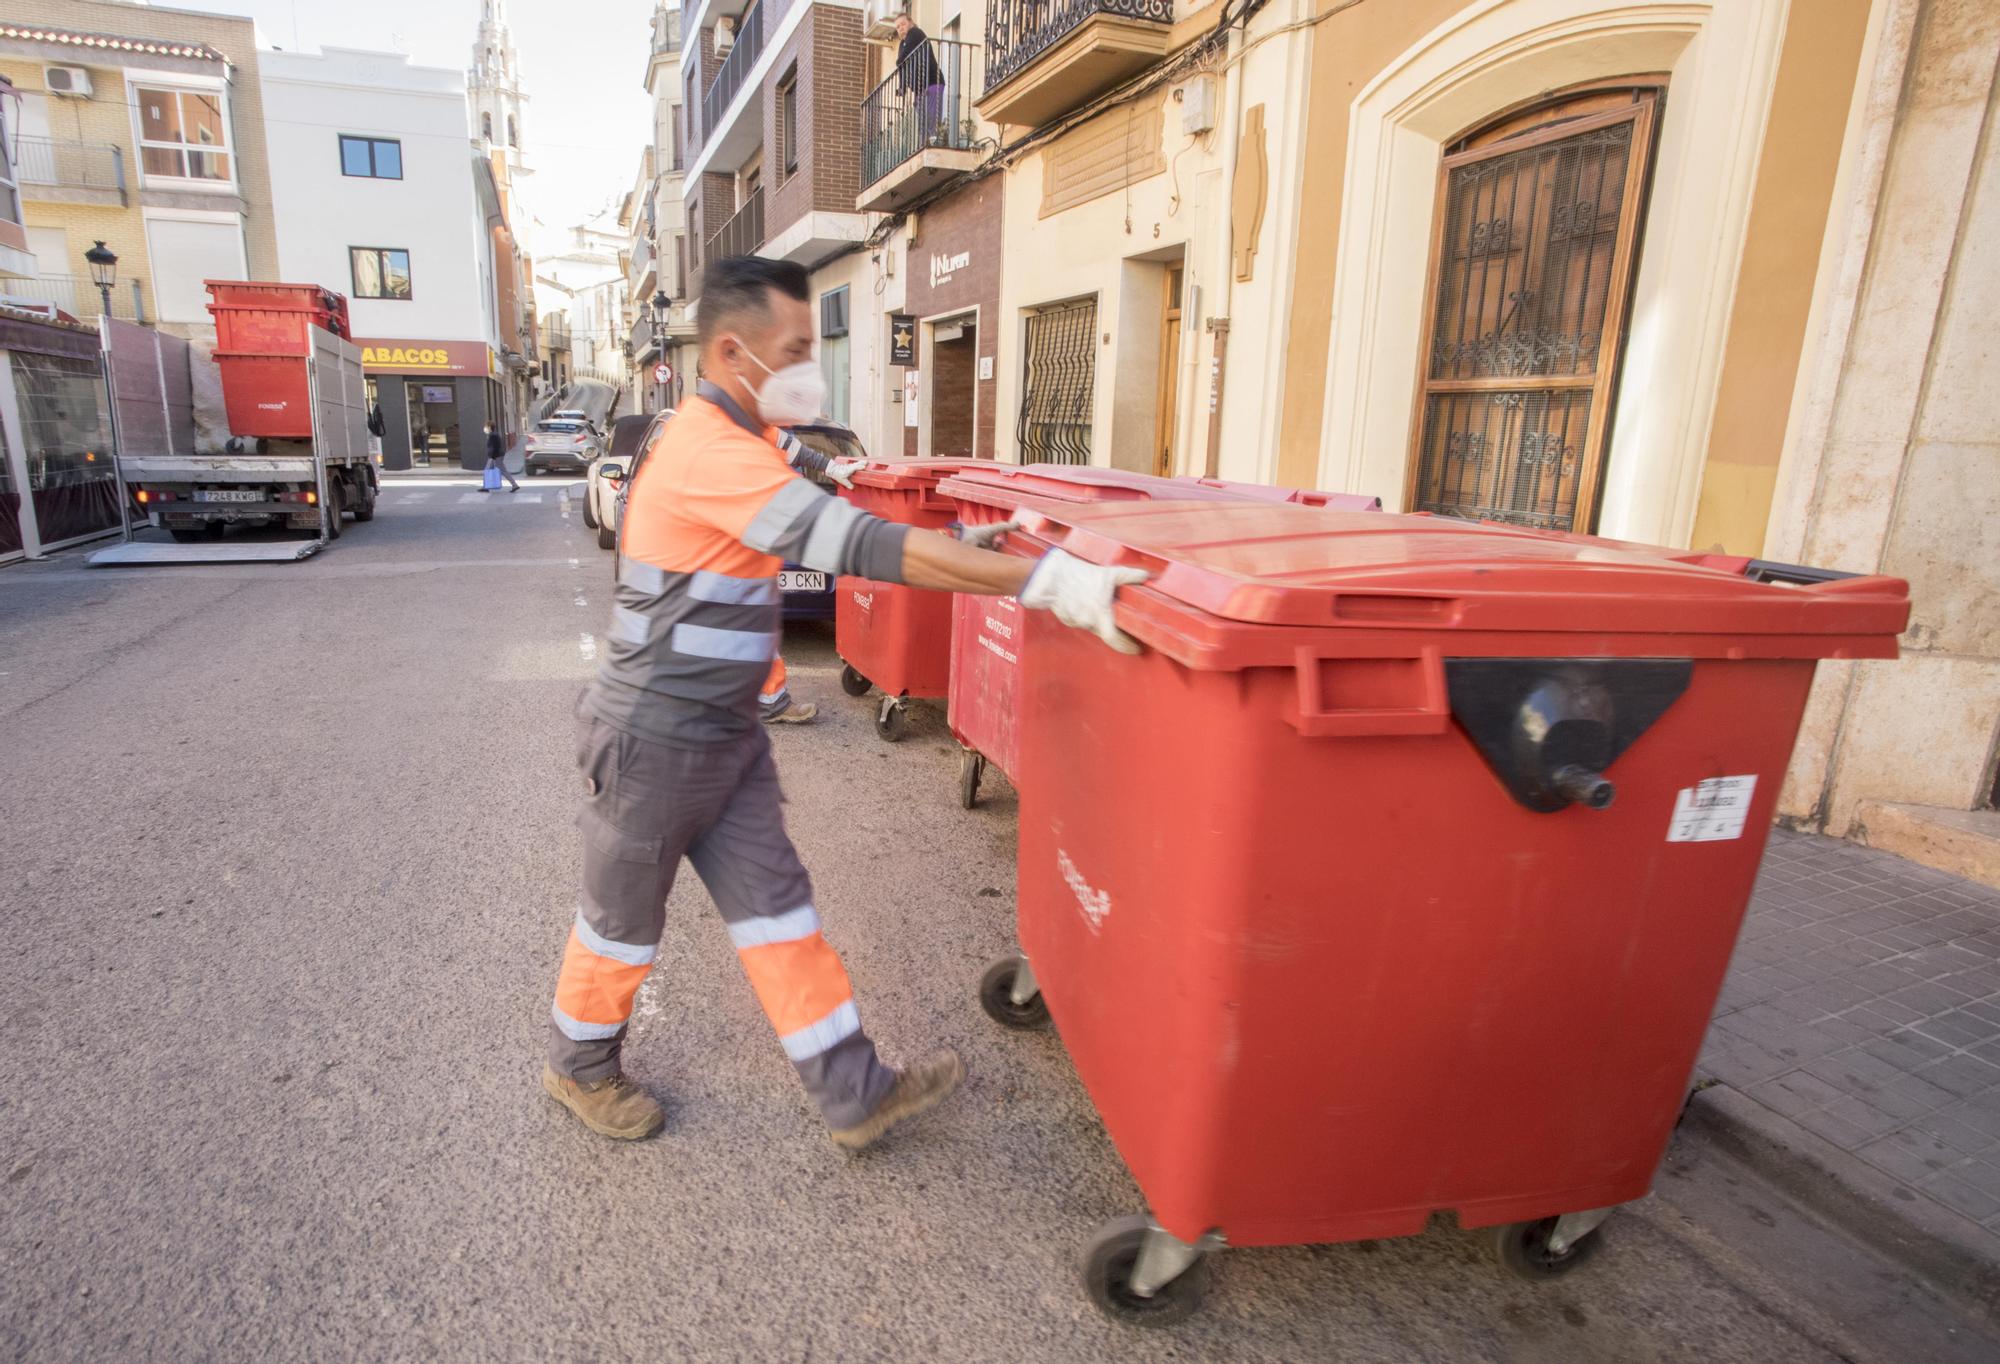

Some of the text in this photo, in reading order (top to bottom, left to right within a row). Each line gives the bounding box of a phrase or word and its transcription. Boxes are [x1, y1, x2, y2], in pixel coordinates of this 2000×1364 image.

[1153, 222, 1161, 239] 5
[362, 347, 449, 364] ABACOS
[779, 573, 822, 588] 3 CKN
